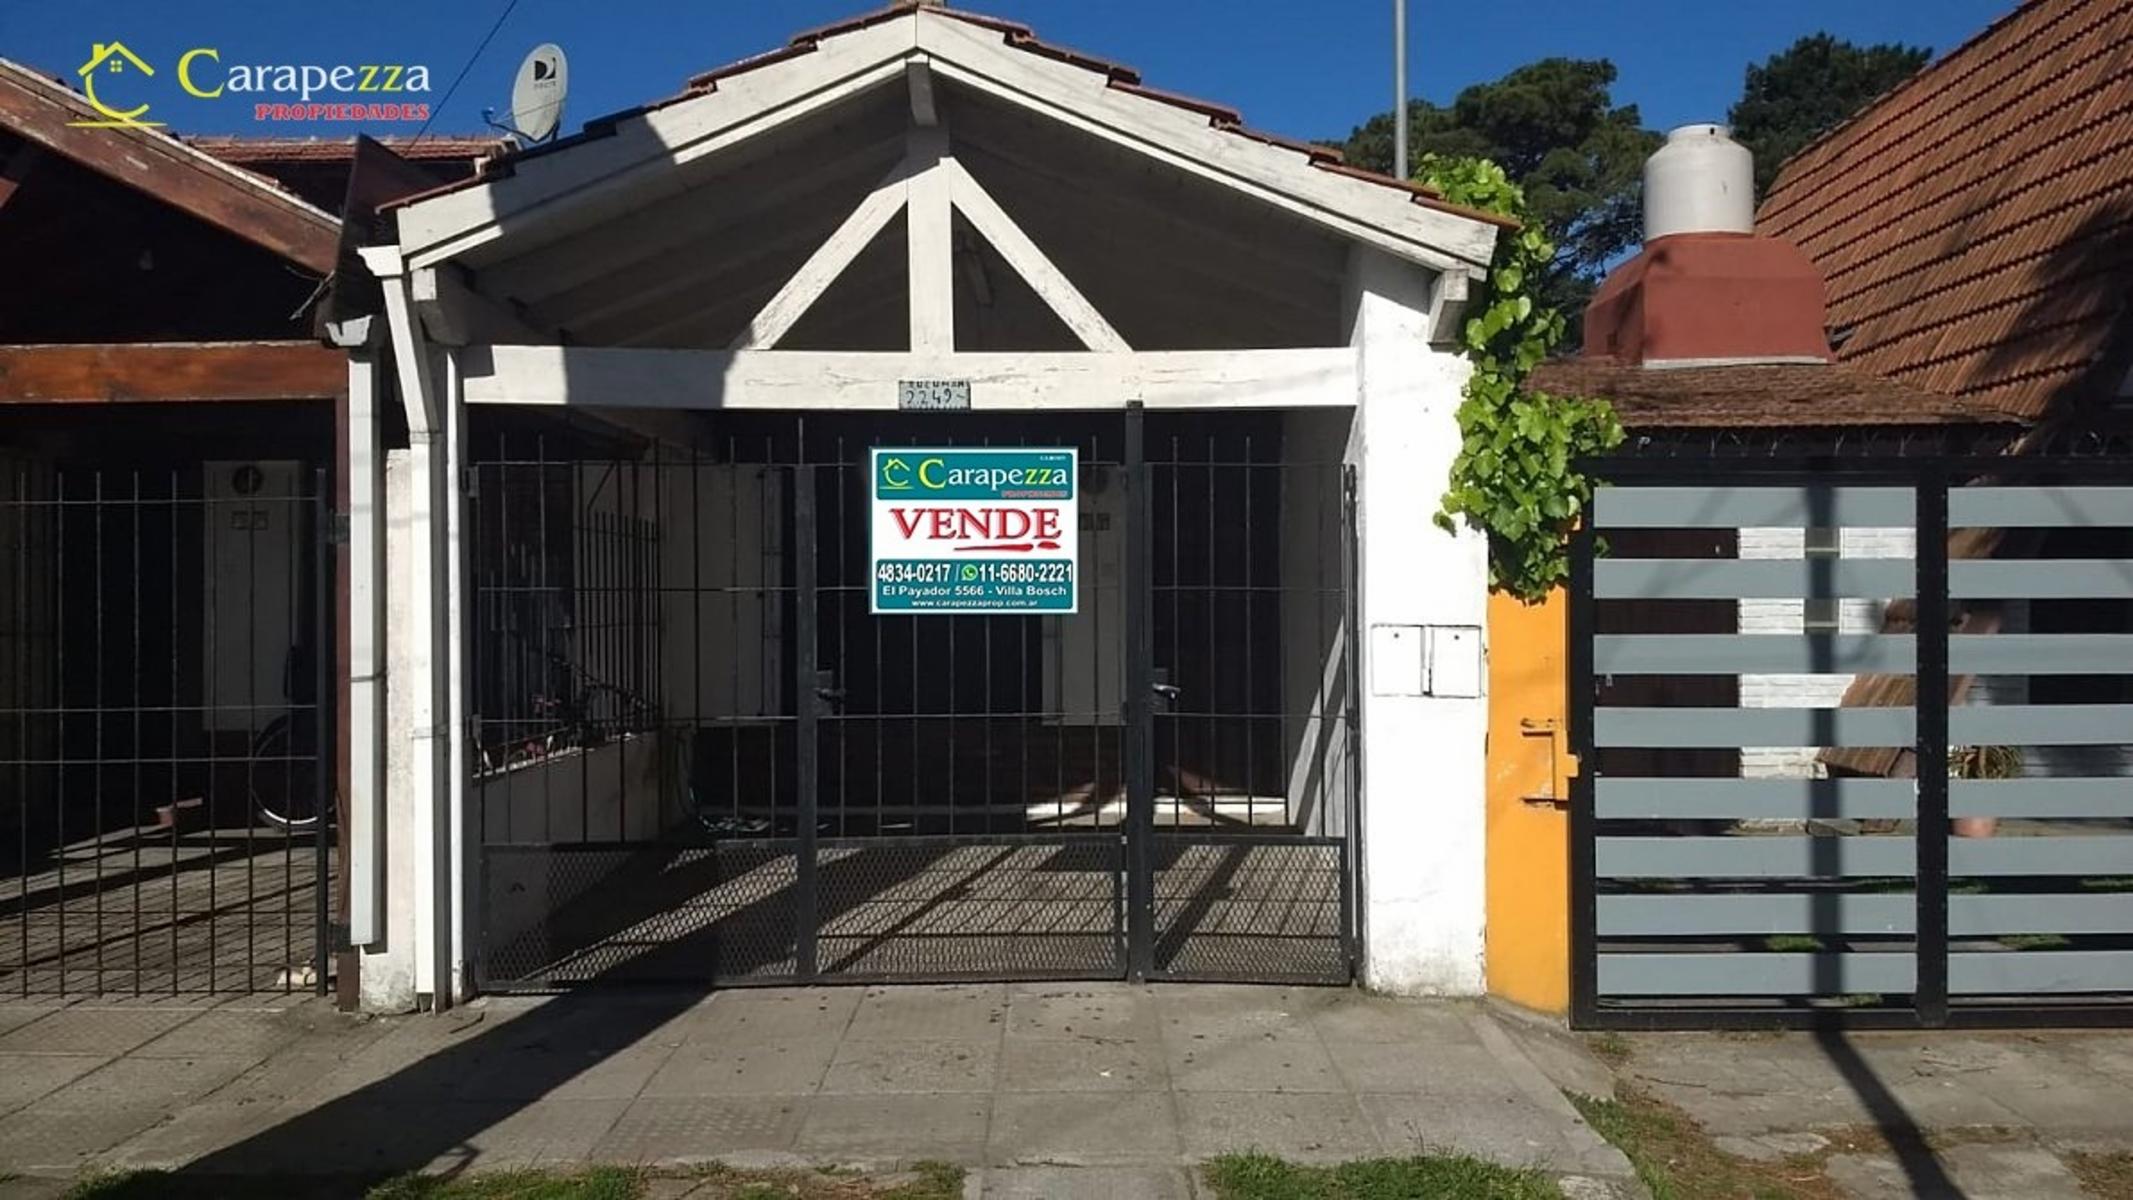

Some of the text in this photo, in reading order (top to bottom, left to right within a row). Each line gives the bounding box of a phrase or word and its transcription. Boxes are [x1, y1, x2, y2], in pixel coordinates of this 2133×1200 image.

[918, 458, 1068, 491] Carapezza
[889, 508, 1063, 540] VENDE
[878, 563, 951, 582] 4834-0217
[979, 563, 1072, 582] 11-6680-2221
[882, 585, 895, 596] El
[898, 585, 951, 599] Payador
[954, 585, 984, 596] 5566
[995, 585, 1023, 596] Villa
[1026, 585, 1067, 596] Bosch
